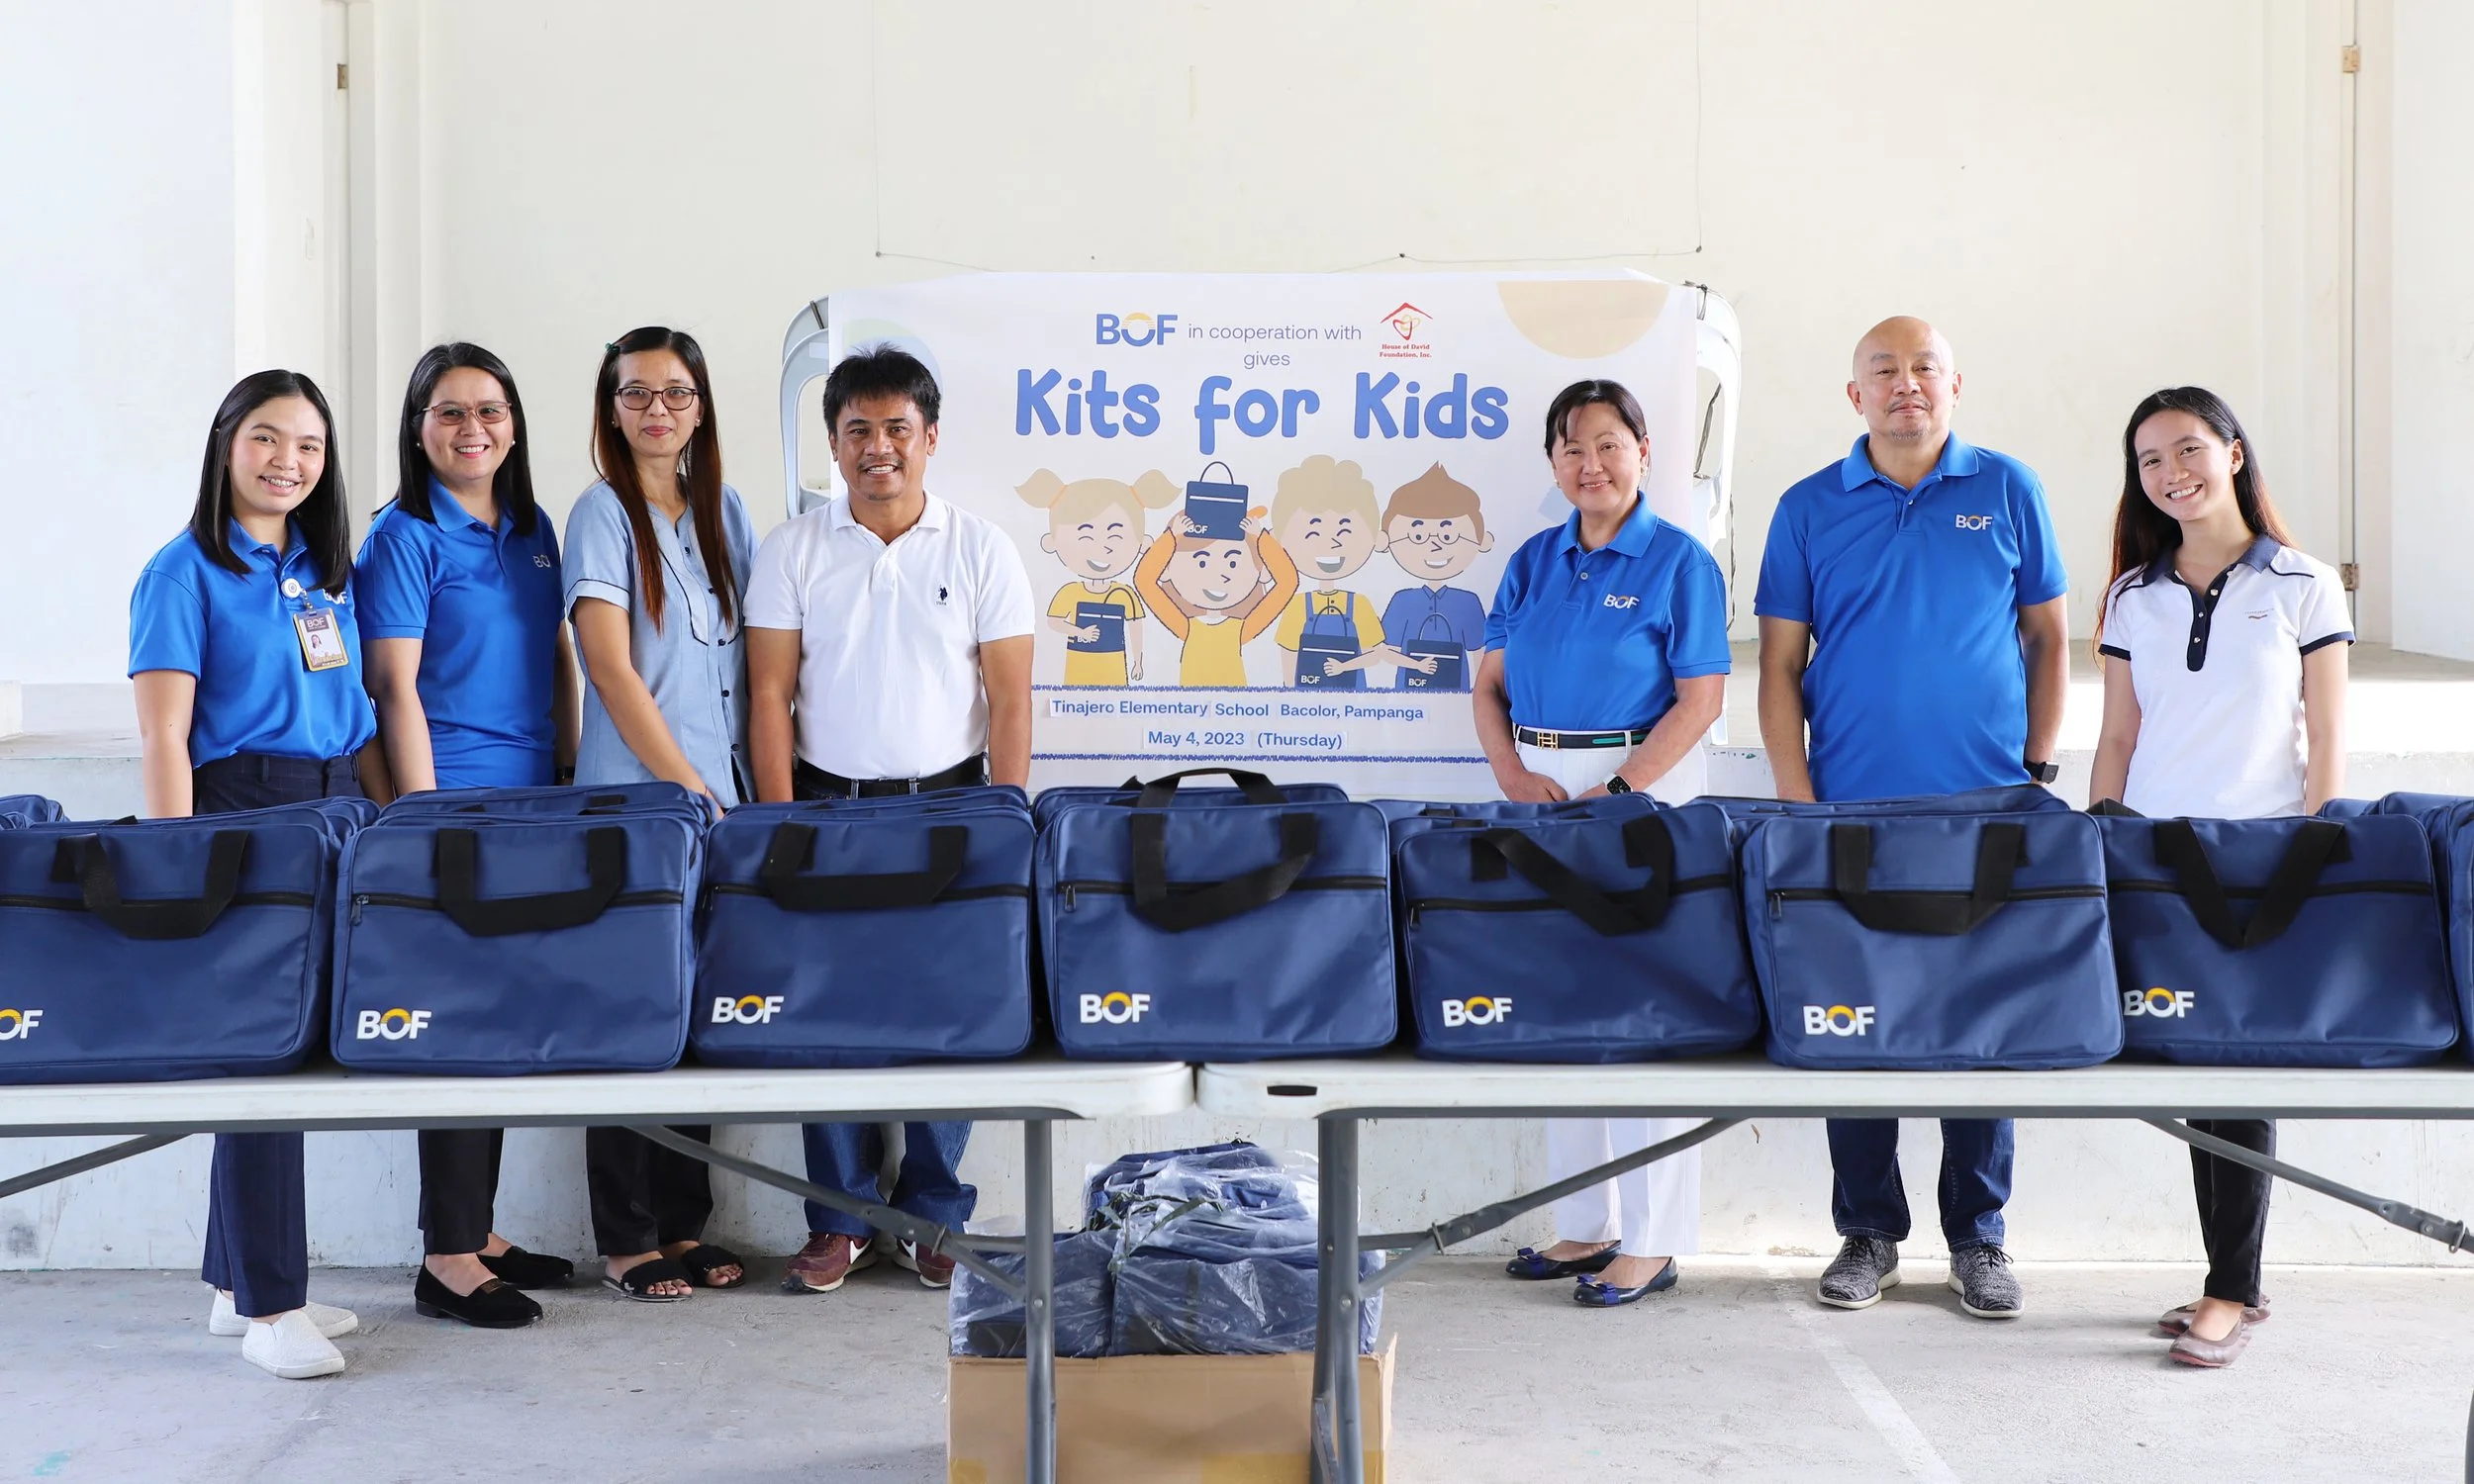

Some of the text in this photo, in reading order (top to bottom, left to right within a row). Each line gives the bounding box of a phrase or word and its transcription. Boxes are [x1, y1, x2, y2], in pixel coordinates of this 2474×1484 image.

[1096, 313, 1362, 346] BOF in cooperation with
[1243, 351, 1290, 369] gives
[1015, 368, 1508, 455] Kits for Kids
[1955, 514, 1993, 530] BOF
[533, 555, 550, 568] BO
[1603, 594, 1640, 609] BOF
[307, 617, 325, 627] BOF
[1300, 675, 1321, 684] BOF
[1408, 678, 1427, 687] BOF
[1052, 700, 1424, 721] Tinajero Elementary School Bacolor, Pampanga
[1148, 731, 1342, 750] May 4, 2023 (Thursday)
[712, 995, 785, 1025] BOF
[1080, 991, 1151, 1024] BOF
[1442, 995, 1512, 1027] BOF
[2124, 987, 2195, 1018] BOF
[0, 1009, 43, 1040] OF
[356, 1008, 431, 1041] BOF
[1803, 1004, 1875, 1037] BOF
